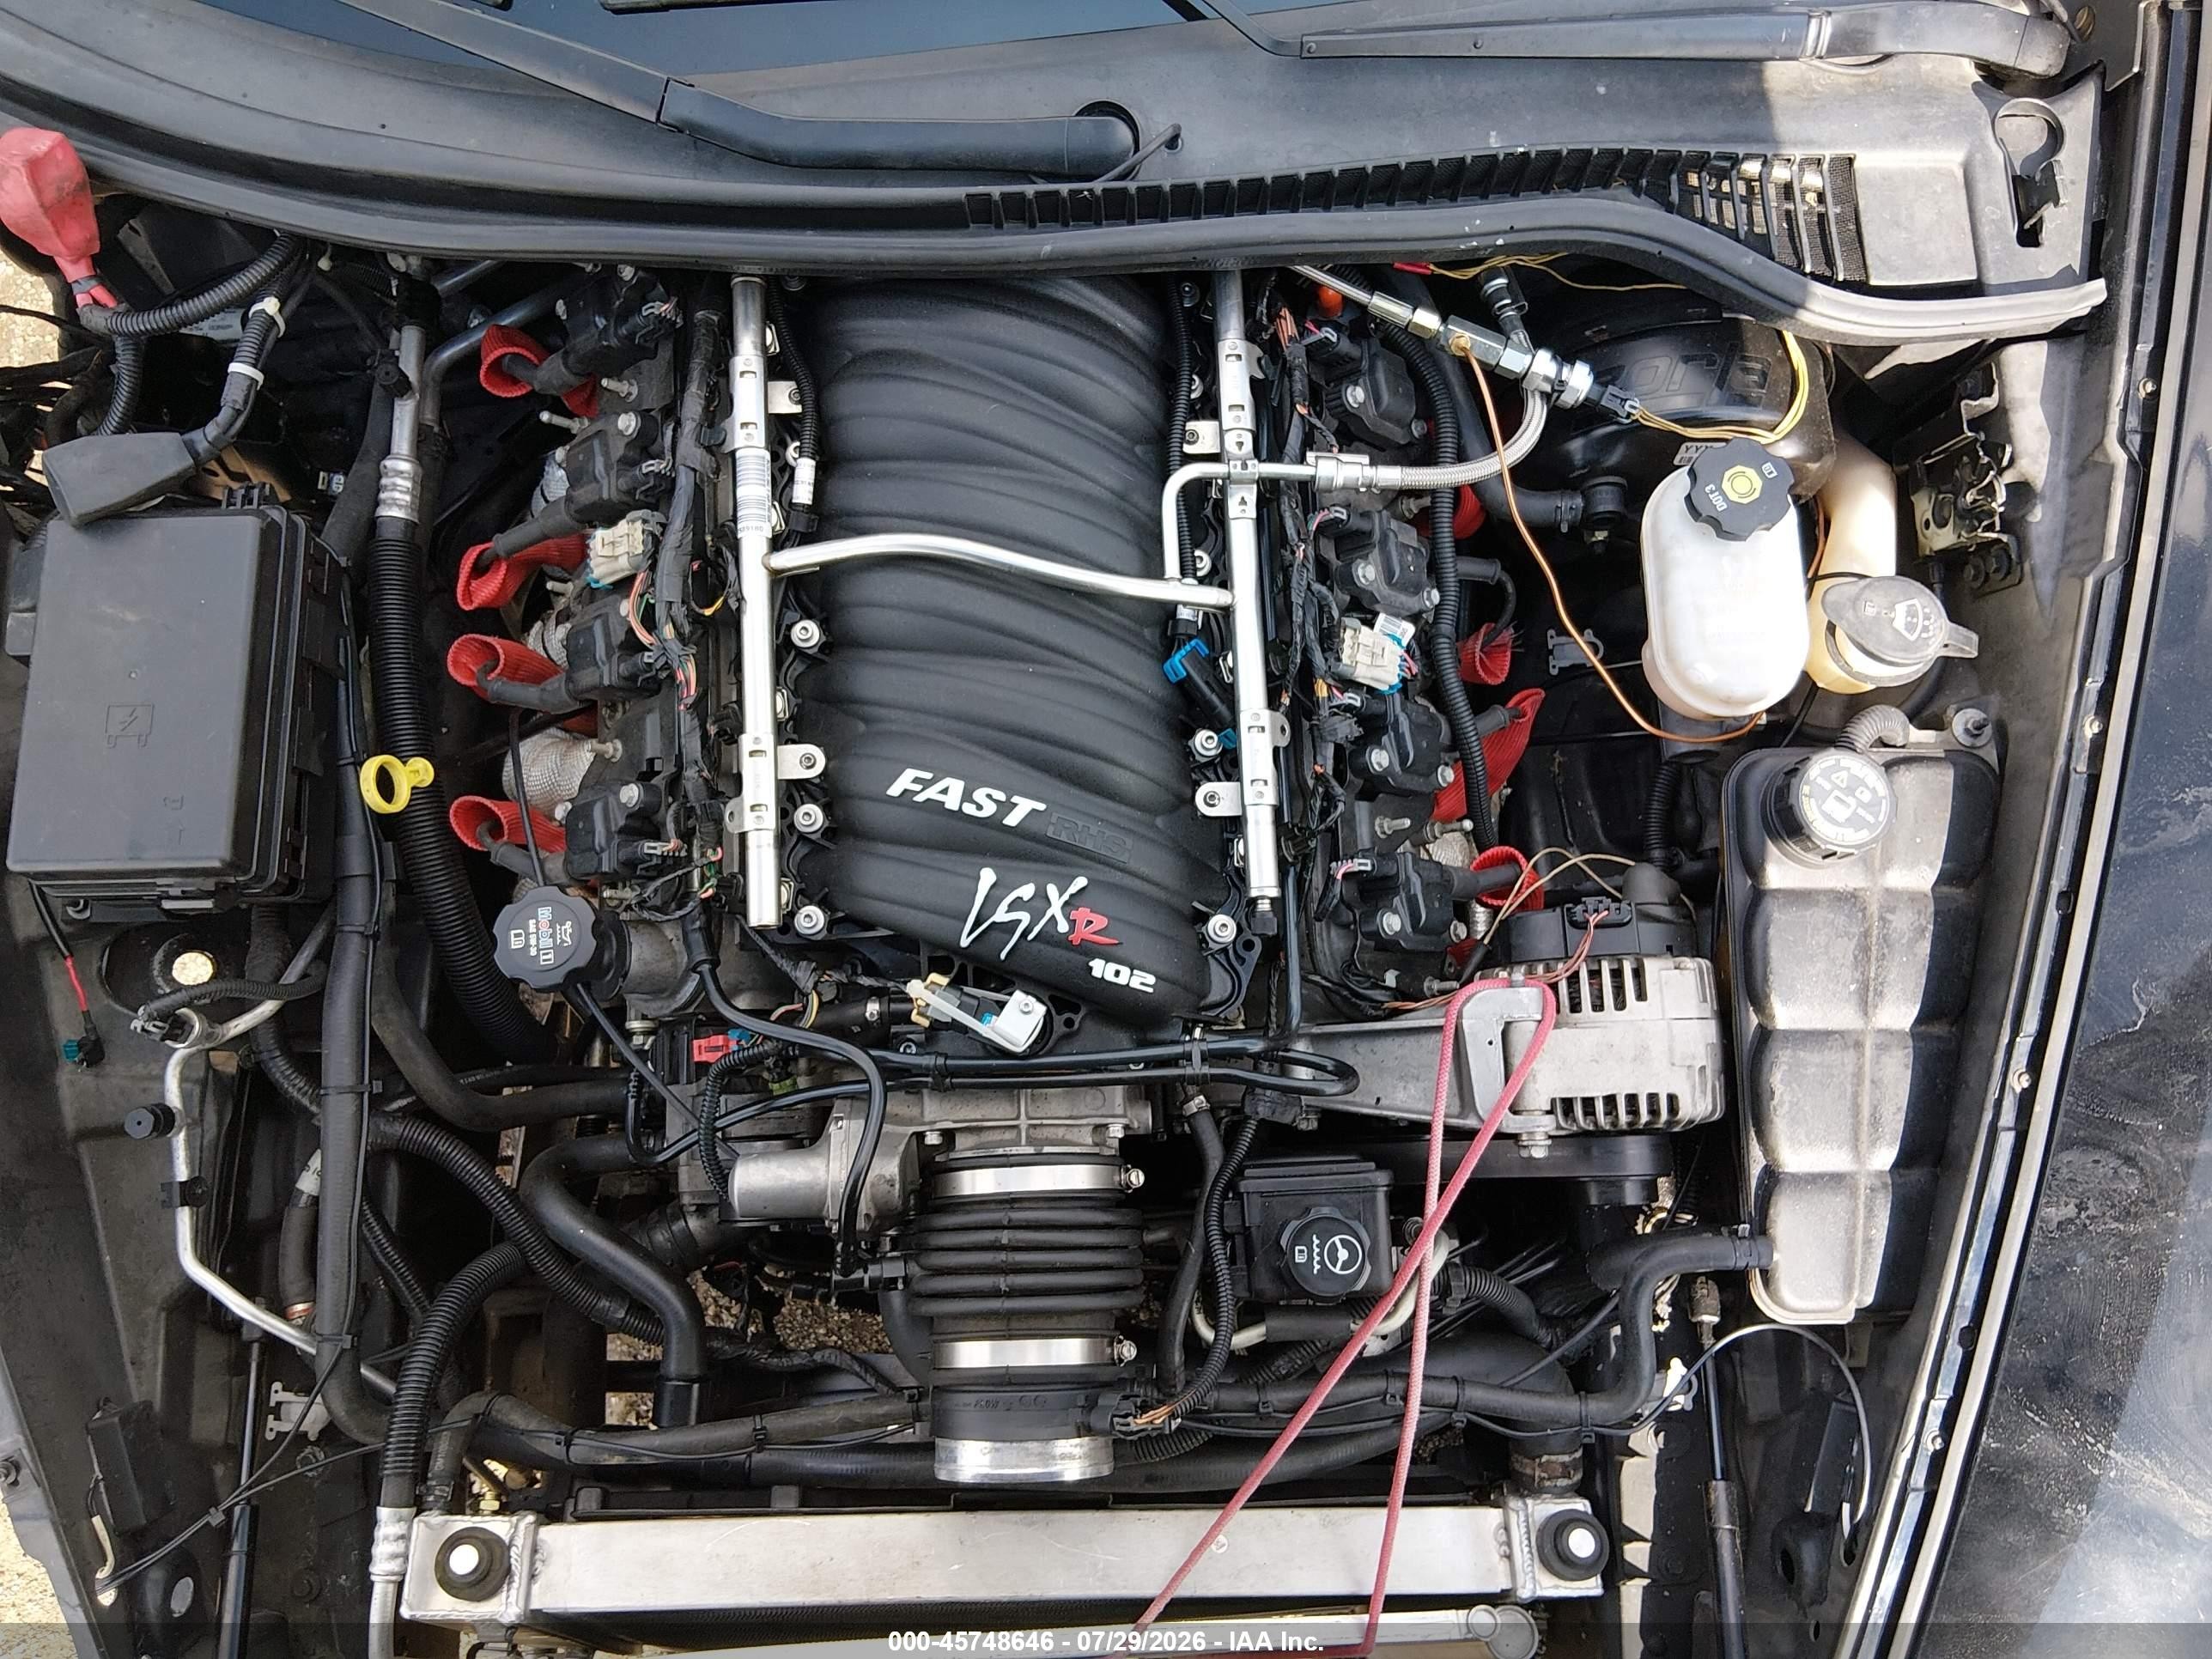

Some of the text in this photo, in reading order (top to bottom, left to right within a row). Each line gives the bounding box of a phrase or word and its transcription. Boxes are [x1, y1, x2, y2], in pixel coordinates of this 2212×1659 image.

[1685, 445, 1713, 453] YY
[1705, 483, 1728, 512] DOT3
[886, 768, 1047, 827] FAST
[538, 907, 554, 965] Mobil 1
[1088, 958, 1157, 994] 102
